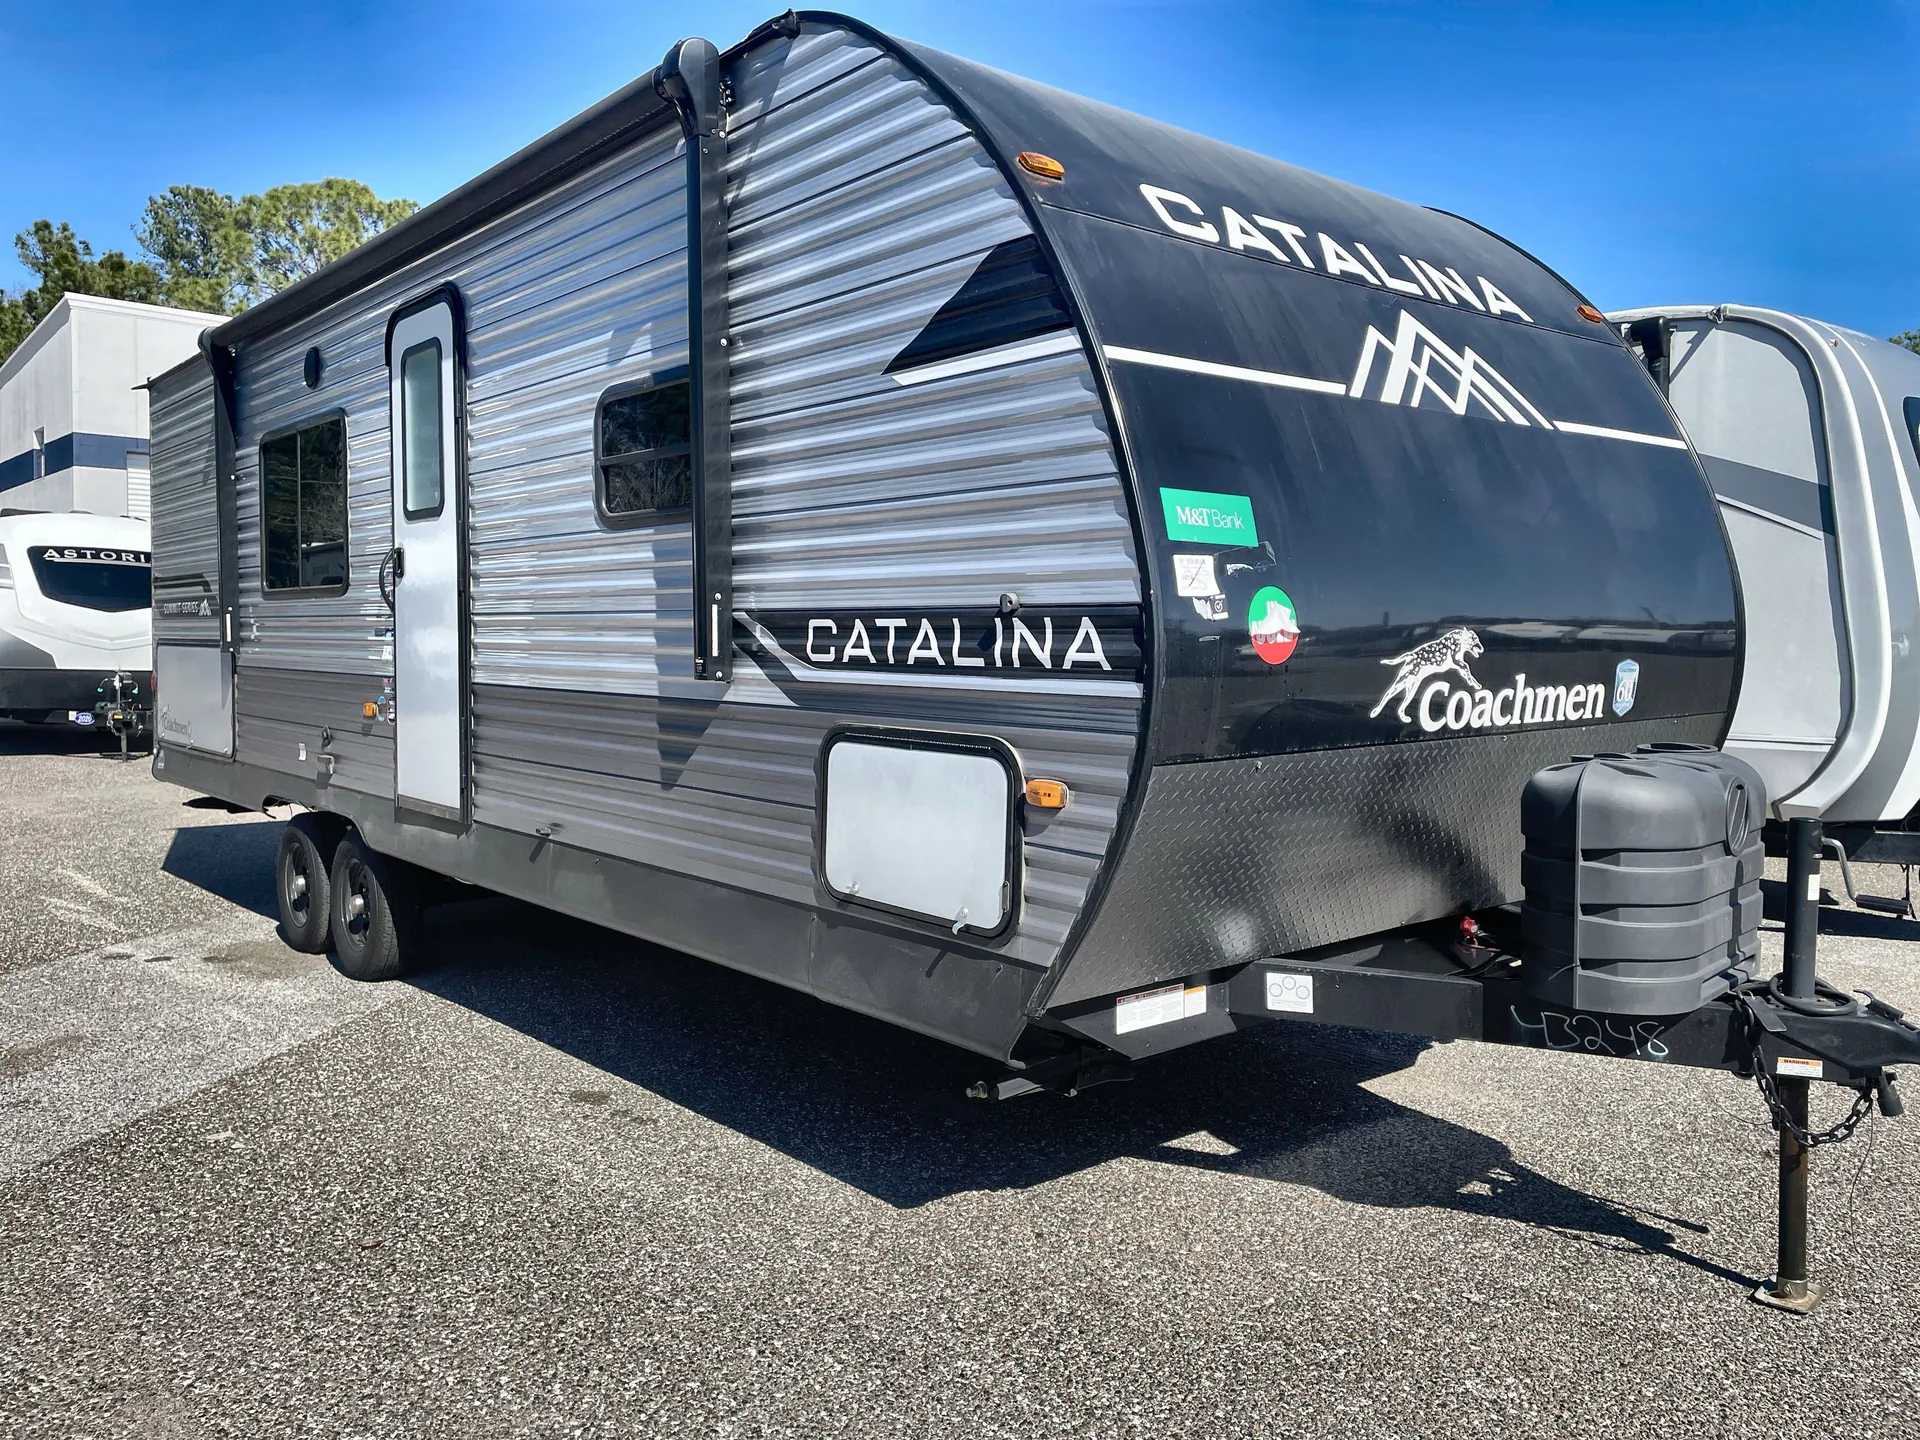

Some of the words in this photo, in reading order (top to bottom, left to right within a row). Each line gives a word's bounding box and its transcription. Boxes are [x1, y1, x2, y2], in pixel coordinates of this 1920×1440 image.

[1139, 183, 1534, 322] CATALINA
[1174, 505, 1210, 527] M&T
[1210, 509, 1245, 530] Bank
[43, 549, 151, 564] ASTORI
[182, 601, 198, 613] SERIES
[805, 616, 1112, 671] CATALINA
[1419, 673, 1606, 732] Coachmen
[1616, 679, 1634, 702] 60
[164, 716, 188, 736] Coachmen
